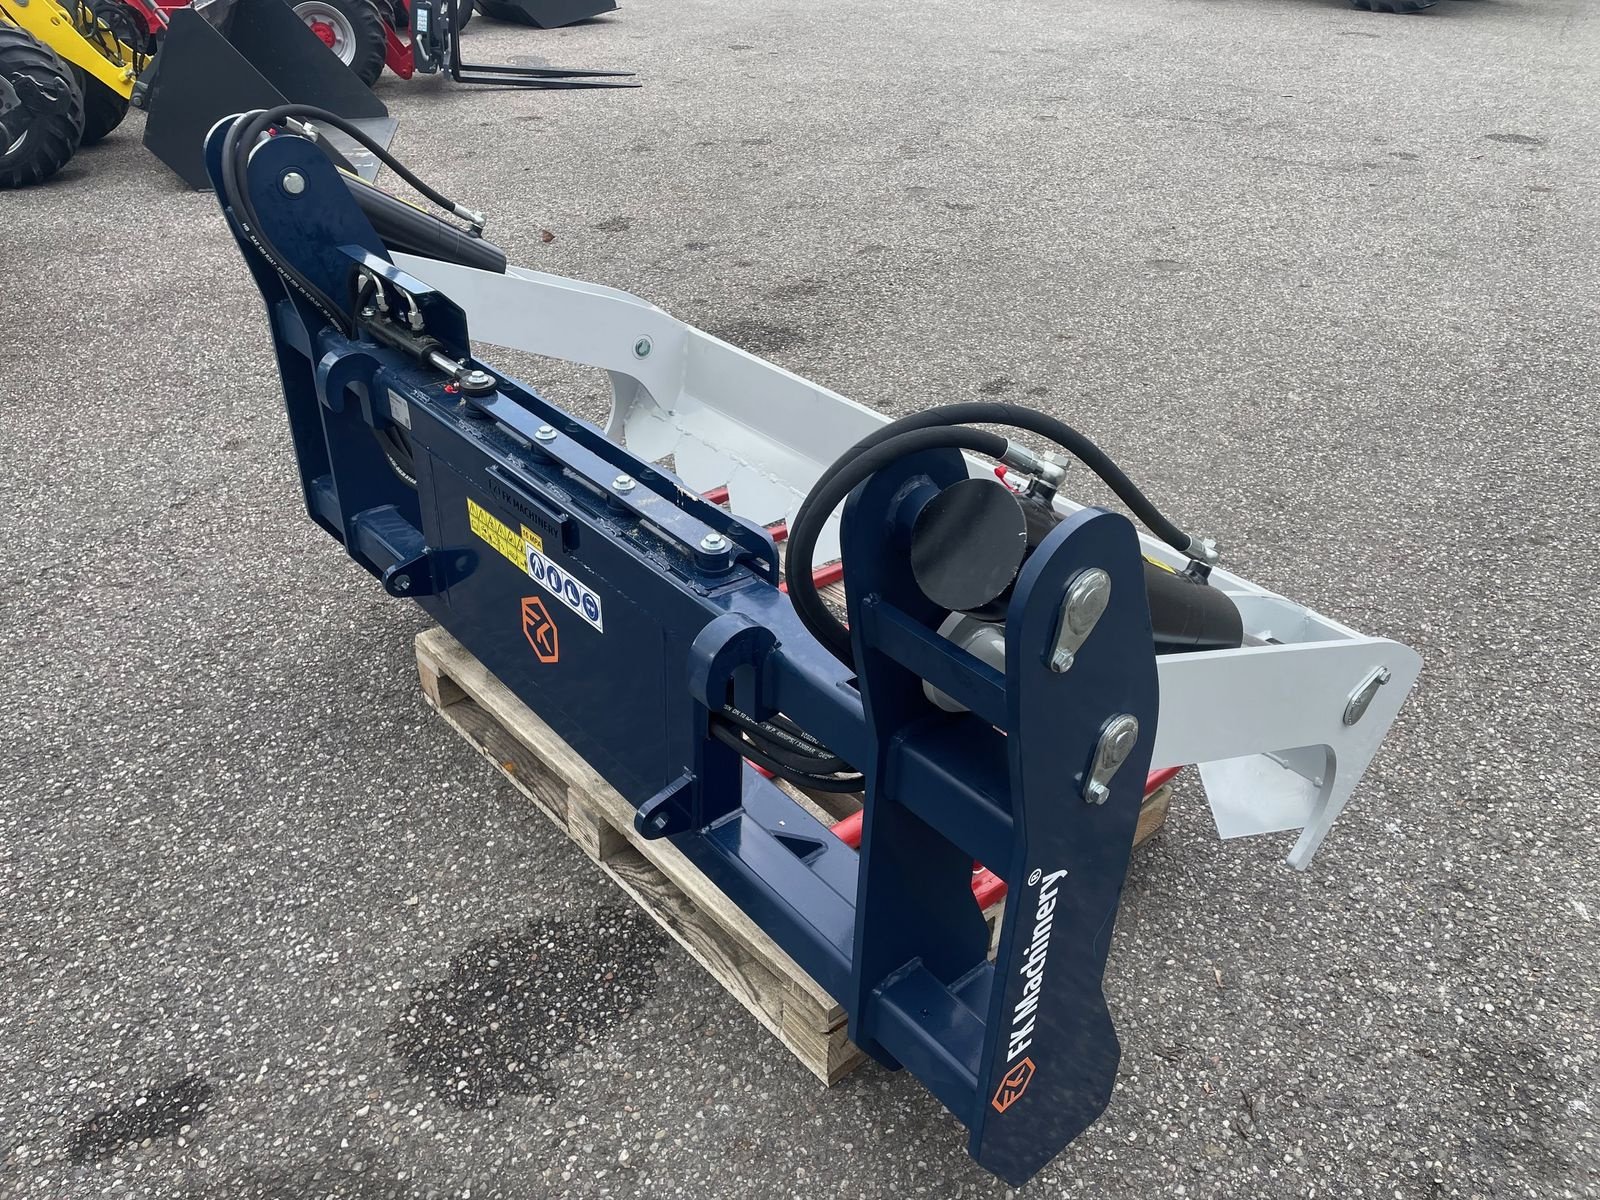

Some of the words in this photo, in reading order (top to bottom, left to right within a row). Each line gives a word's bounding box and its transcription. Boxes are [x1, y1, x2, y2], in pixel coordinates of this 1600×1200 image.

[250, 235, 260, 246] SAE
[258, 245, 266, 256] 100
[512, 496, 559, 538] MACHINERY
[1007, 1014, 1035, 1063] FK
